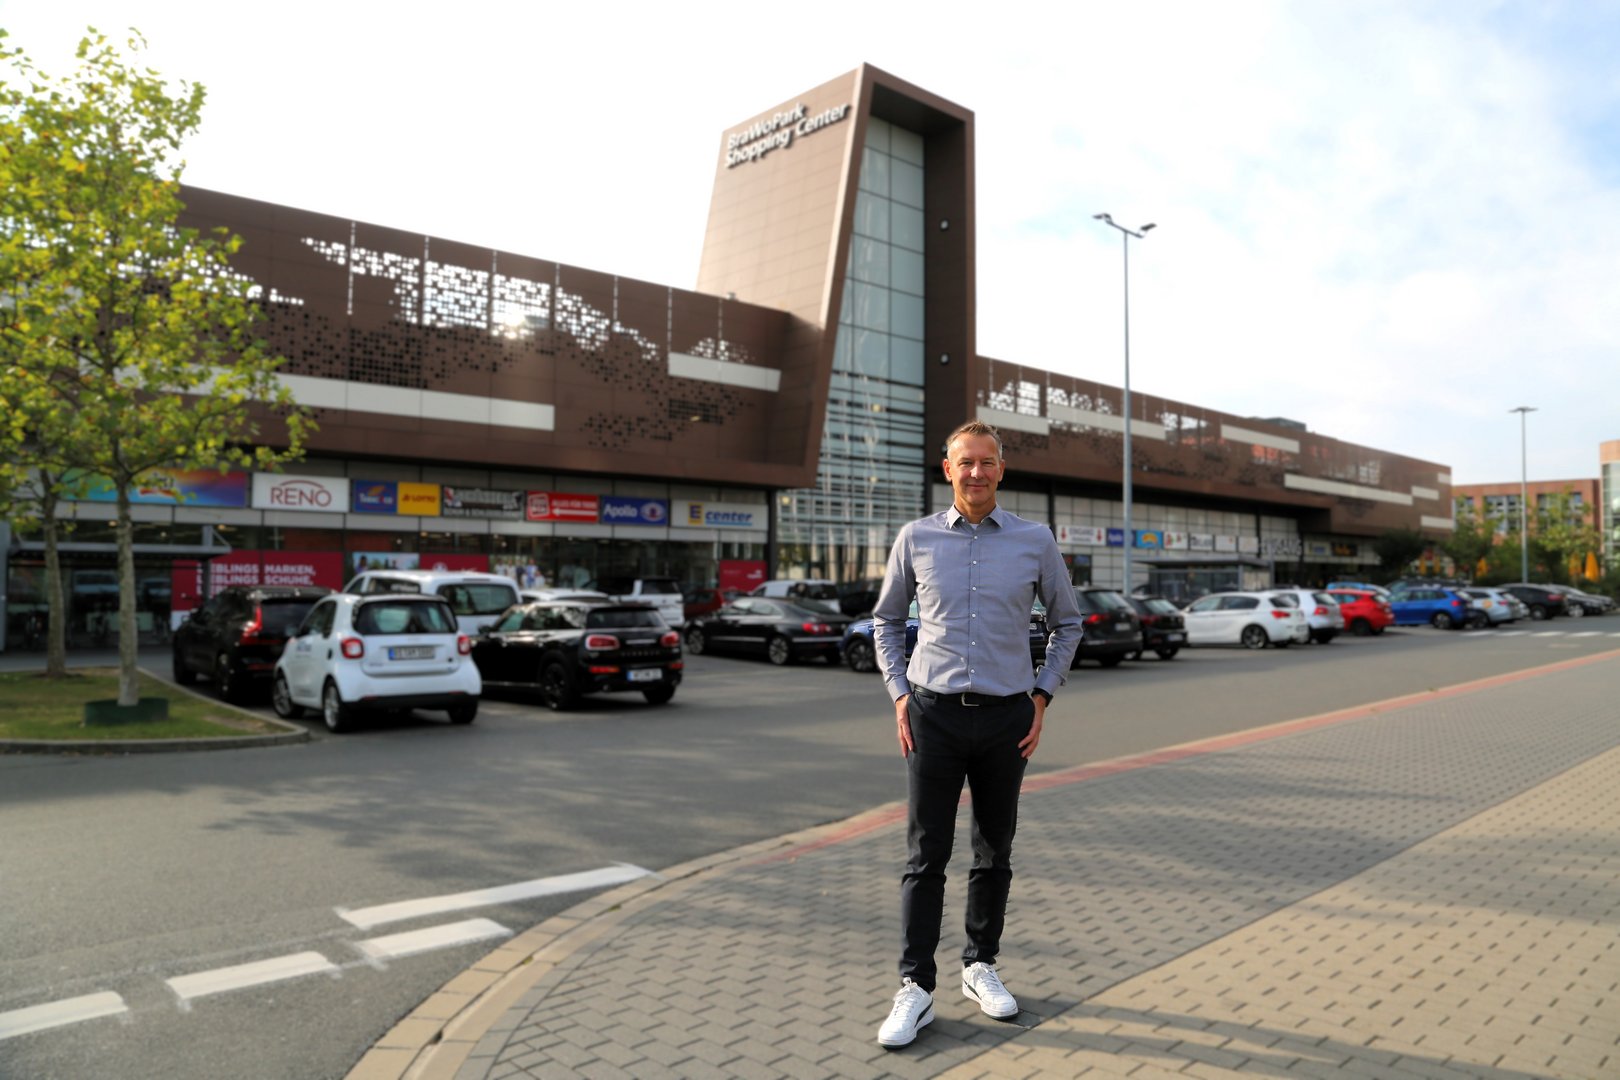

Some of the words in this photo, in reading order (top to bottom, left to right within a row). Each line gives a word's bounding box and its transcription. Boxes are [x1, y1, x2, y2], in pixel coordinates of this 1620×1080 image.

[727, 103, 808, 149] BraWoPark
[725, 129, 794, 169] Shopping
[795, 103, 852, 137] Center
[270, 486, 332, 508] RENO
[604, 503, 638, 518] Apollo
[705, 511, 752, 522] center
[196, 564, 260, 575] LEBLINGS
[264, 565, 316, 576] MARKEN,
[196, 574, 260, 585] LEBLINGS
